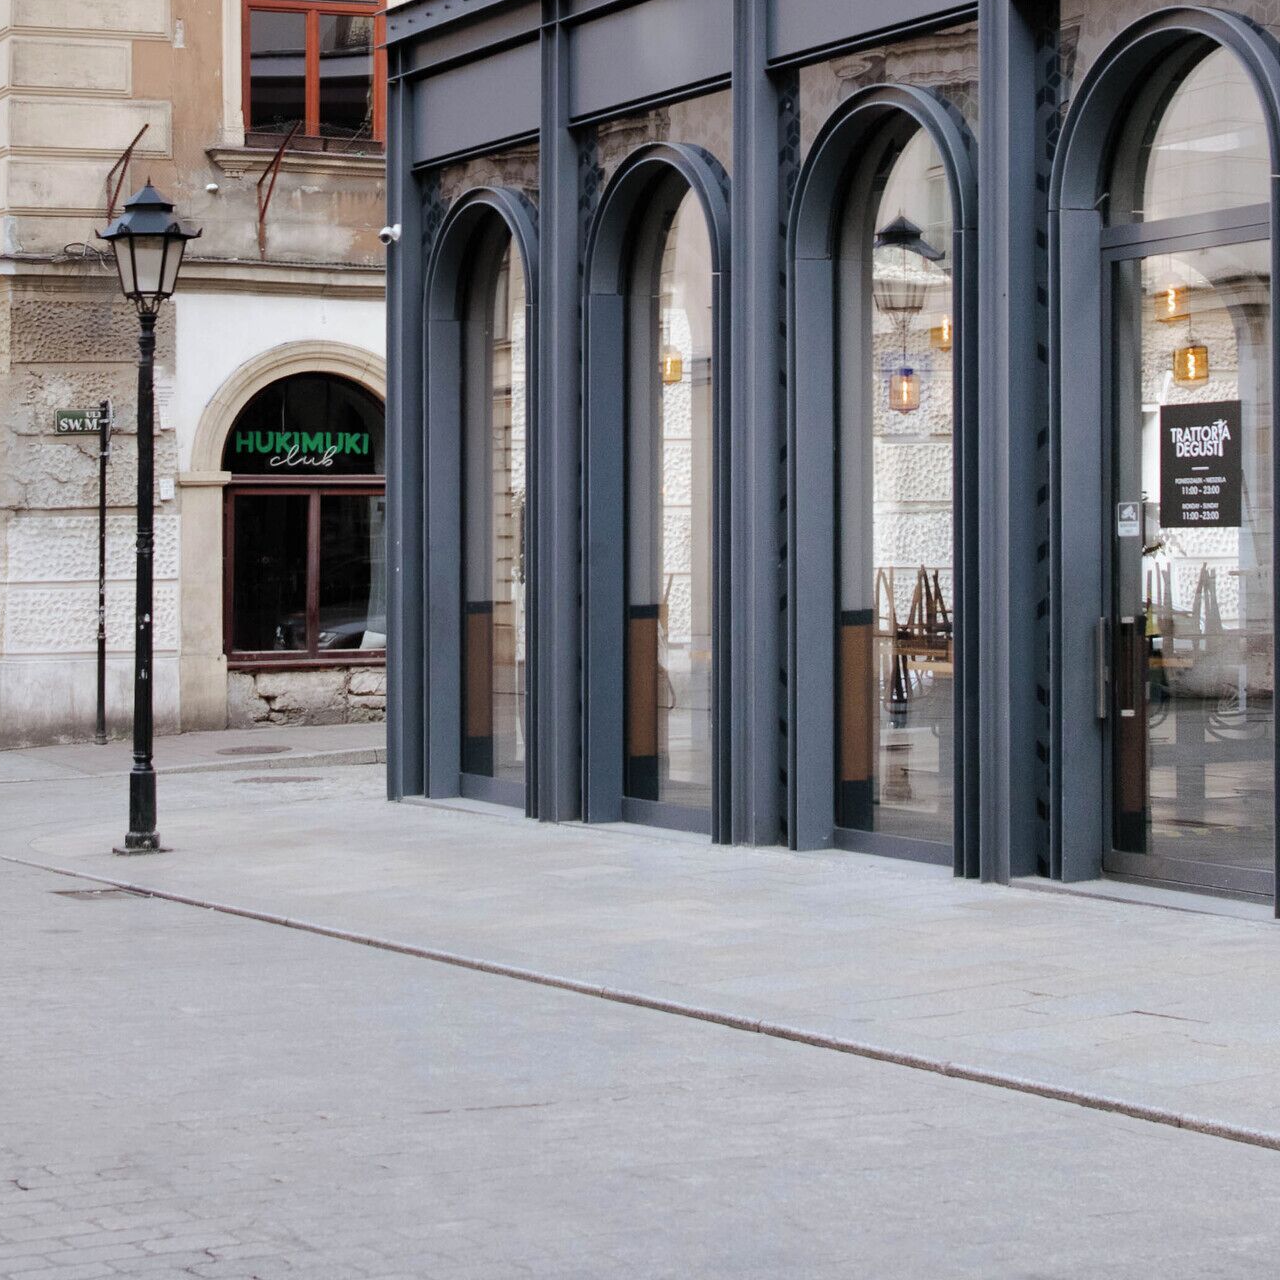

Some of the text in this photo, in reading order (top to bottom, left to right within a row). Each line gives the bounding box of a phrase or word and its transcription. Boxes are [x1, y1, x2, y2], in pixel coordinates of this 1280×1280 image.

[235, 431, 370, 455] HUKIMUKI
[1169, 419, 1231, 443] TRATTORIA
[270, 443, 338, 467] club
[1181, 486, 1198, 495] 11:00
[1203, 485, 1220, 495] 23:00
[1182, 511, 1199, 520] 11:00
